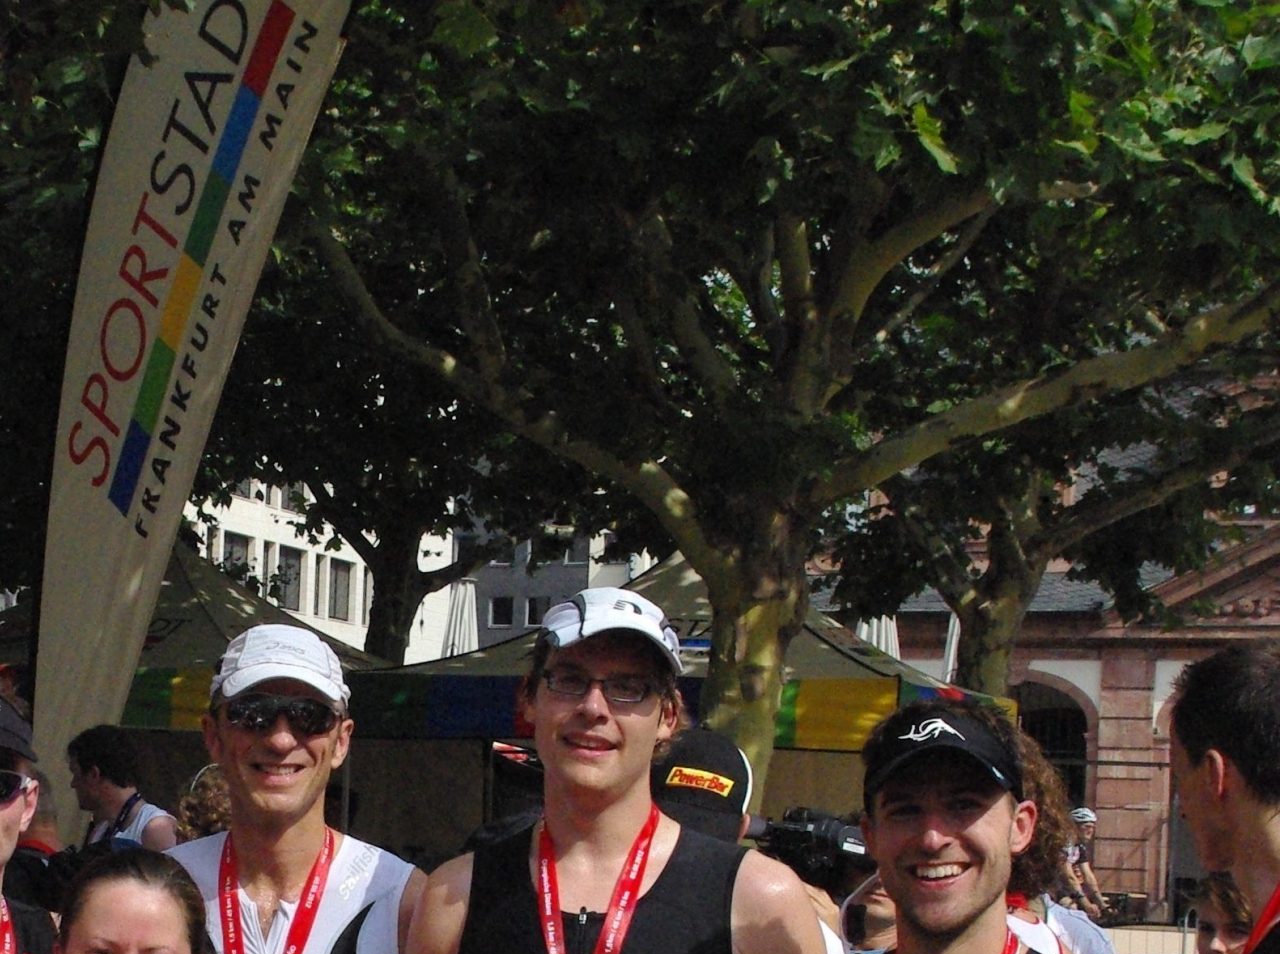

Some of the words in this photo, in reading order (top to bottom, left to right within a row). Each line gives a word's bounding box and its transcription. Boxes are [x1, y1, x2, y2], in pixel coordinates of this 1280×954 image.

[134, 262, 228, 539] FRANKFURT
[229, 174, 261, 246] AM
[259, 20, 318, 151] MAIN
[670, 769, 729, 793] PowerBar
[339, 844, 381, 900] sailfish
[224, 898, 232, 908] km
[543, 893, 552, 915] Distanz
[226, 922, 234, 932] km
[607, 933, 616, 944] km
[615, 910, 624, 920] km
[622, 890, 631, 900] km
[227, 934, 235, 942] 1,5
